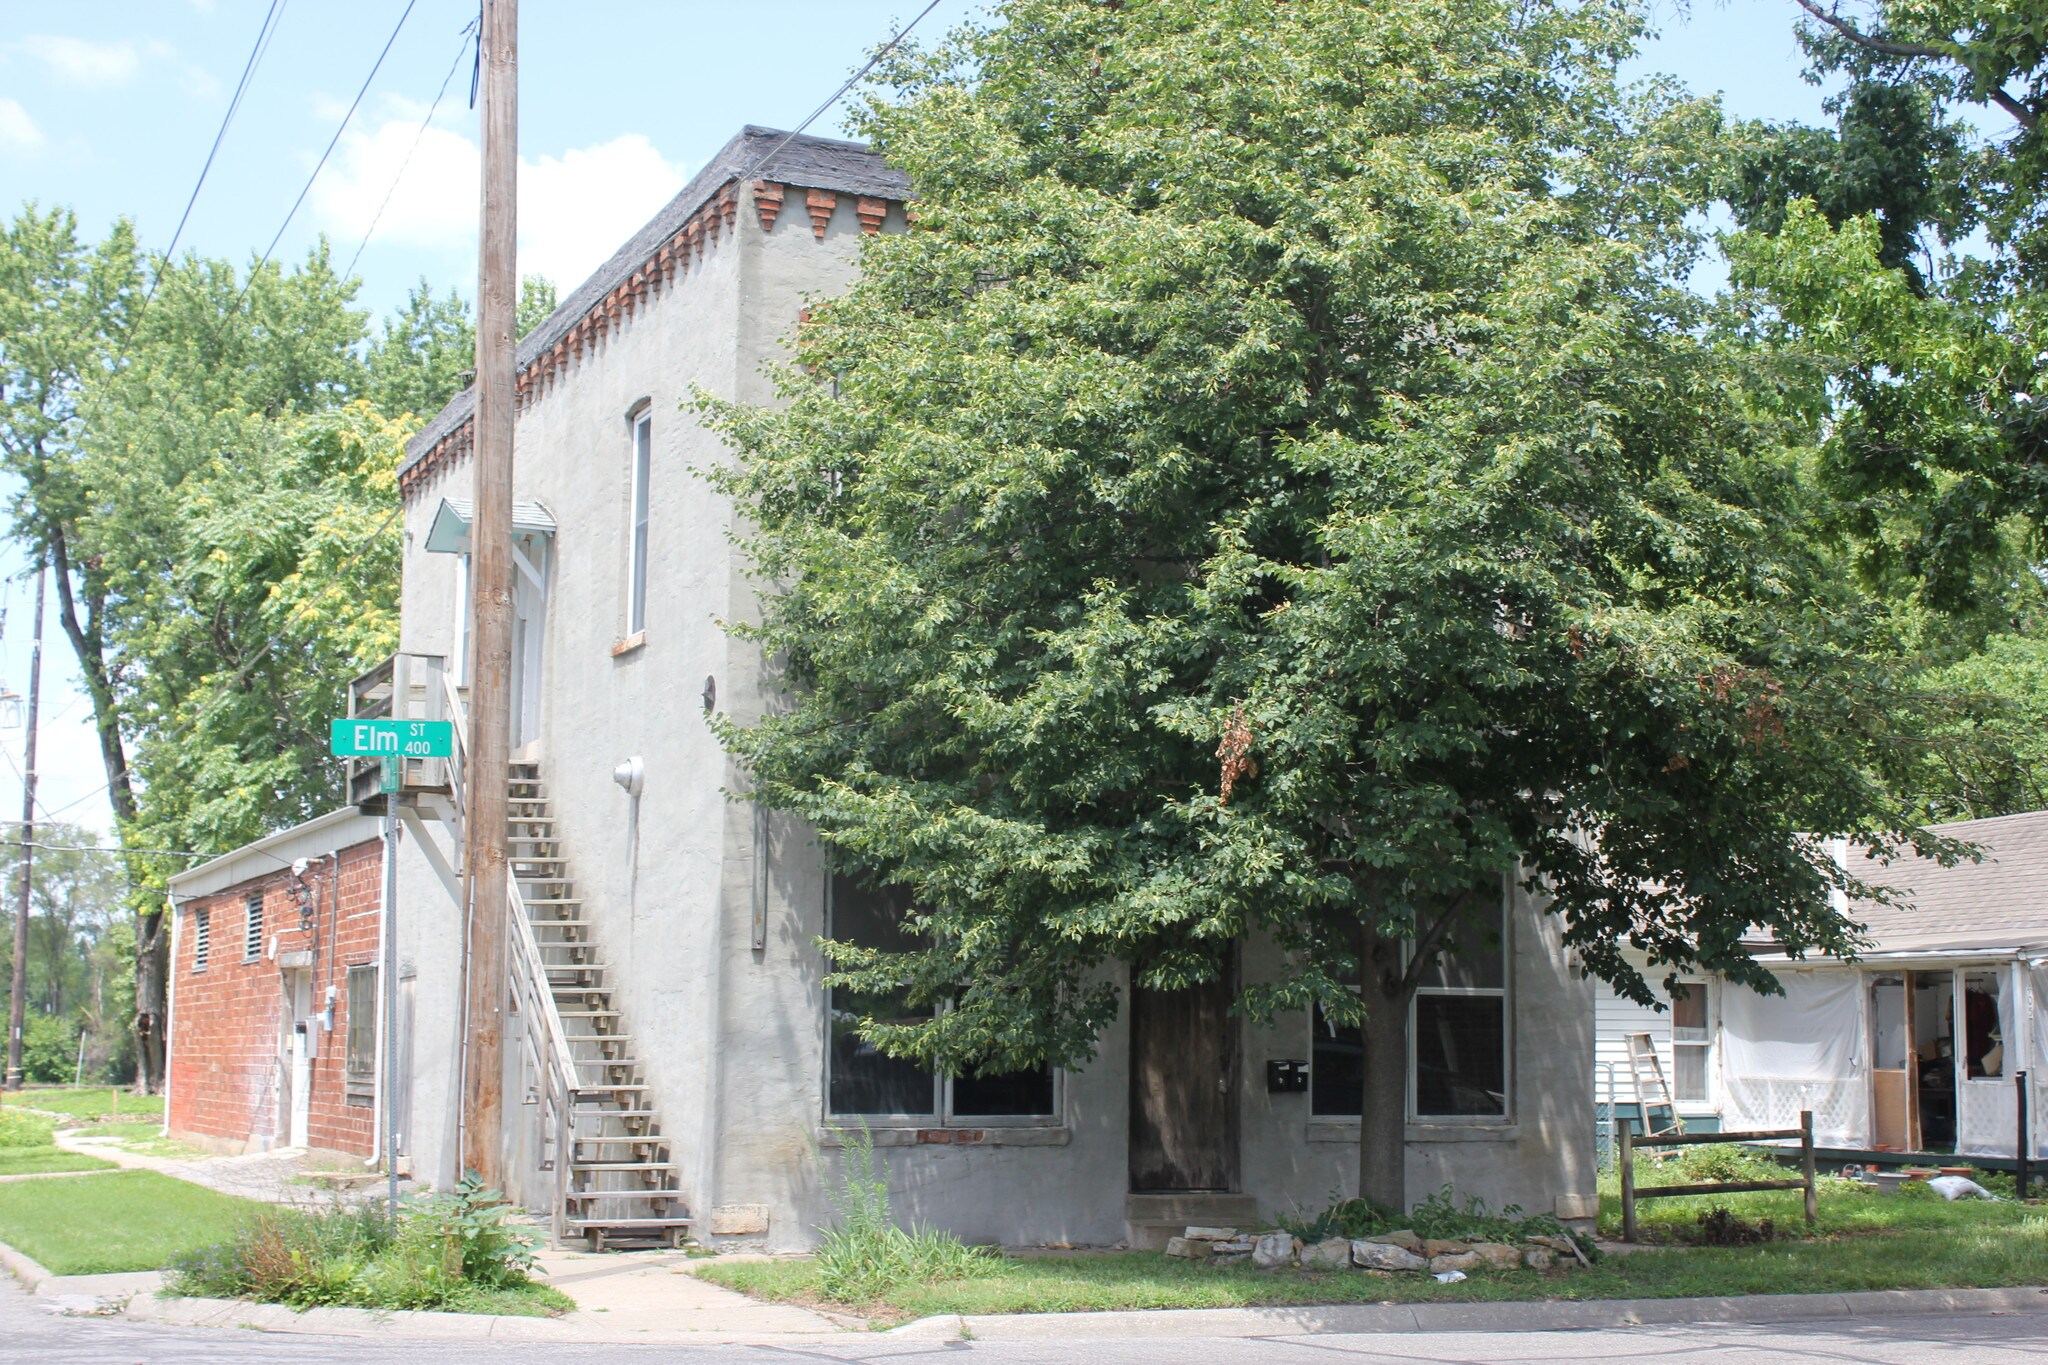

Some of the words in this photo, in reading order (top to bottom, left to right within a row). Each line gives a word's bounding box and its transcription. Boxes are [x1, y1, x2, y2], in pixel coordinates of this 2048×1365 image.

[354, 725, 398, 751] Elm
[409, 723, 426, 736] ST
[404, 741, 431, 754] 400
